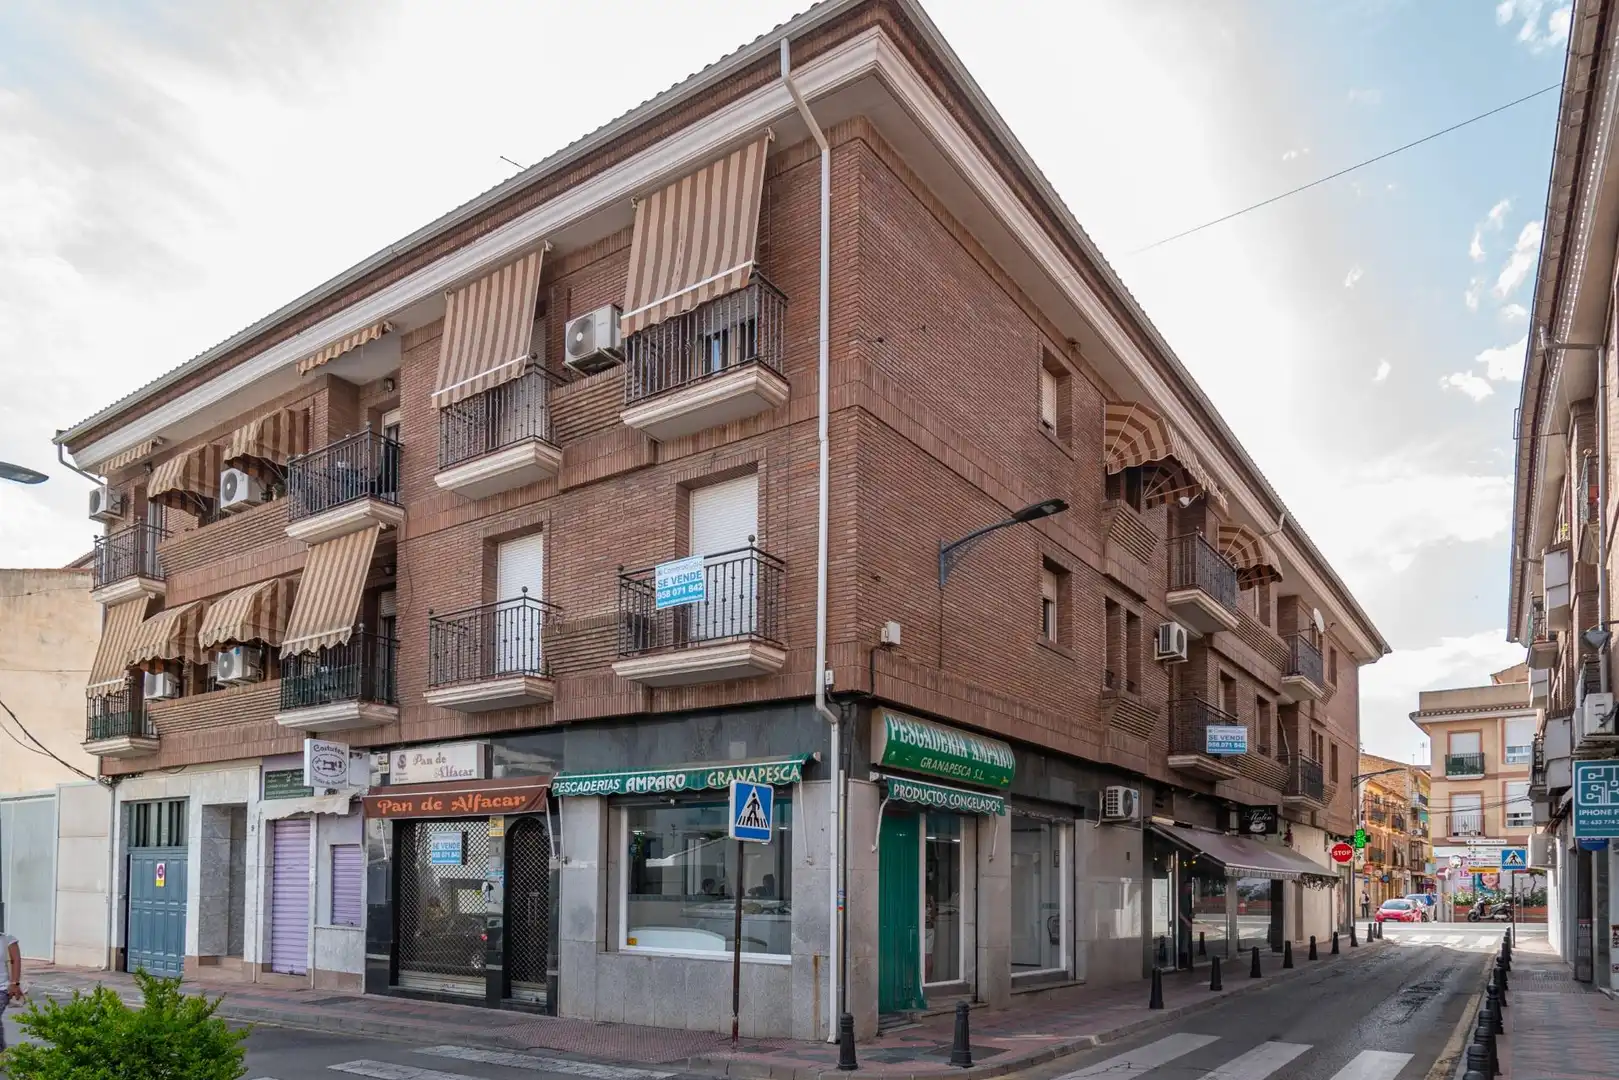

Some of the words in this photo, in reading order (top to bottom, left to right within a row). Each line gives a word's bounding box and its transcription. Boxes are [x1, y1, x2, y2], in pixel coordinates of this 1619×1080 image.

[658, 578, 668, 588] SE
[670, 570, 702, 584] VENDE
[672, 586, 686, 596] 071
[688, 582, 702, 592] 842
[412, 754, 432, 766] Pan
[436, 752, 447, 764] de
[920, 756, 972, 778] GRANAPESCA
[432, 764, 474, 778] Alfacar
[708, 764, 801, 786] GRANAPESCA
[552, 778, 620, 793] PESCADERIAS
[626, 774, 686, 792] AMPARO
[377, 800, 412, 814] Pan
[420, 796, 443, 812] de
[452, 794, 526, 813] Alfacar
[894, 784, 948, 804] PRODUCTOS
[950, 793, 1000, 812] CONGELADOS
